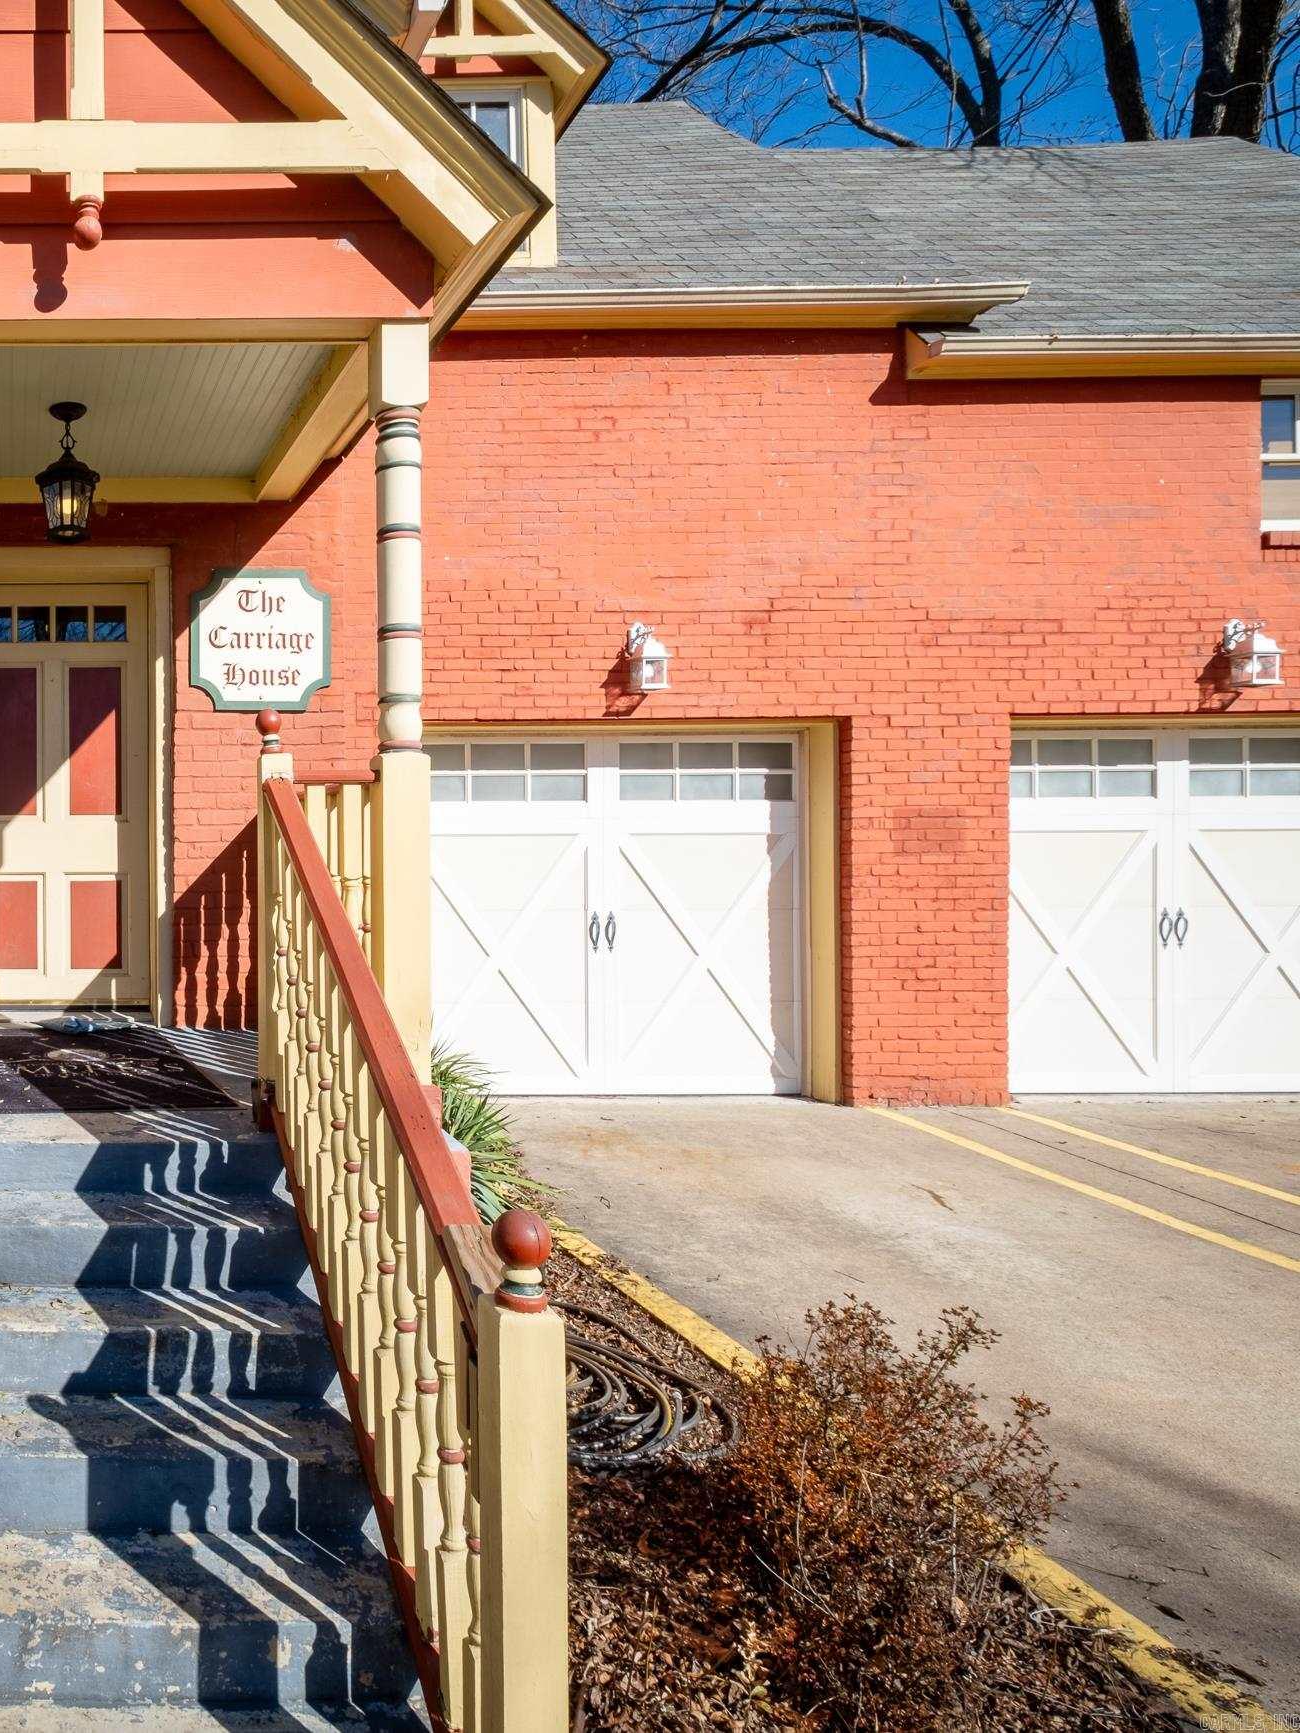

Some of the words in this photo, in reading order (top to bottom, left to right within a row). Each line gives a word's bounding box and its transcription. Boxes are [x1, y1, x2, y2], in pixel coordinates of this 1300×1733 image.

[237, 590, 286, 616] The
[208, 625, 315, 654] Carriage
[222, 663, 301, 690] House
